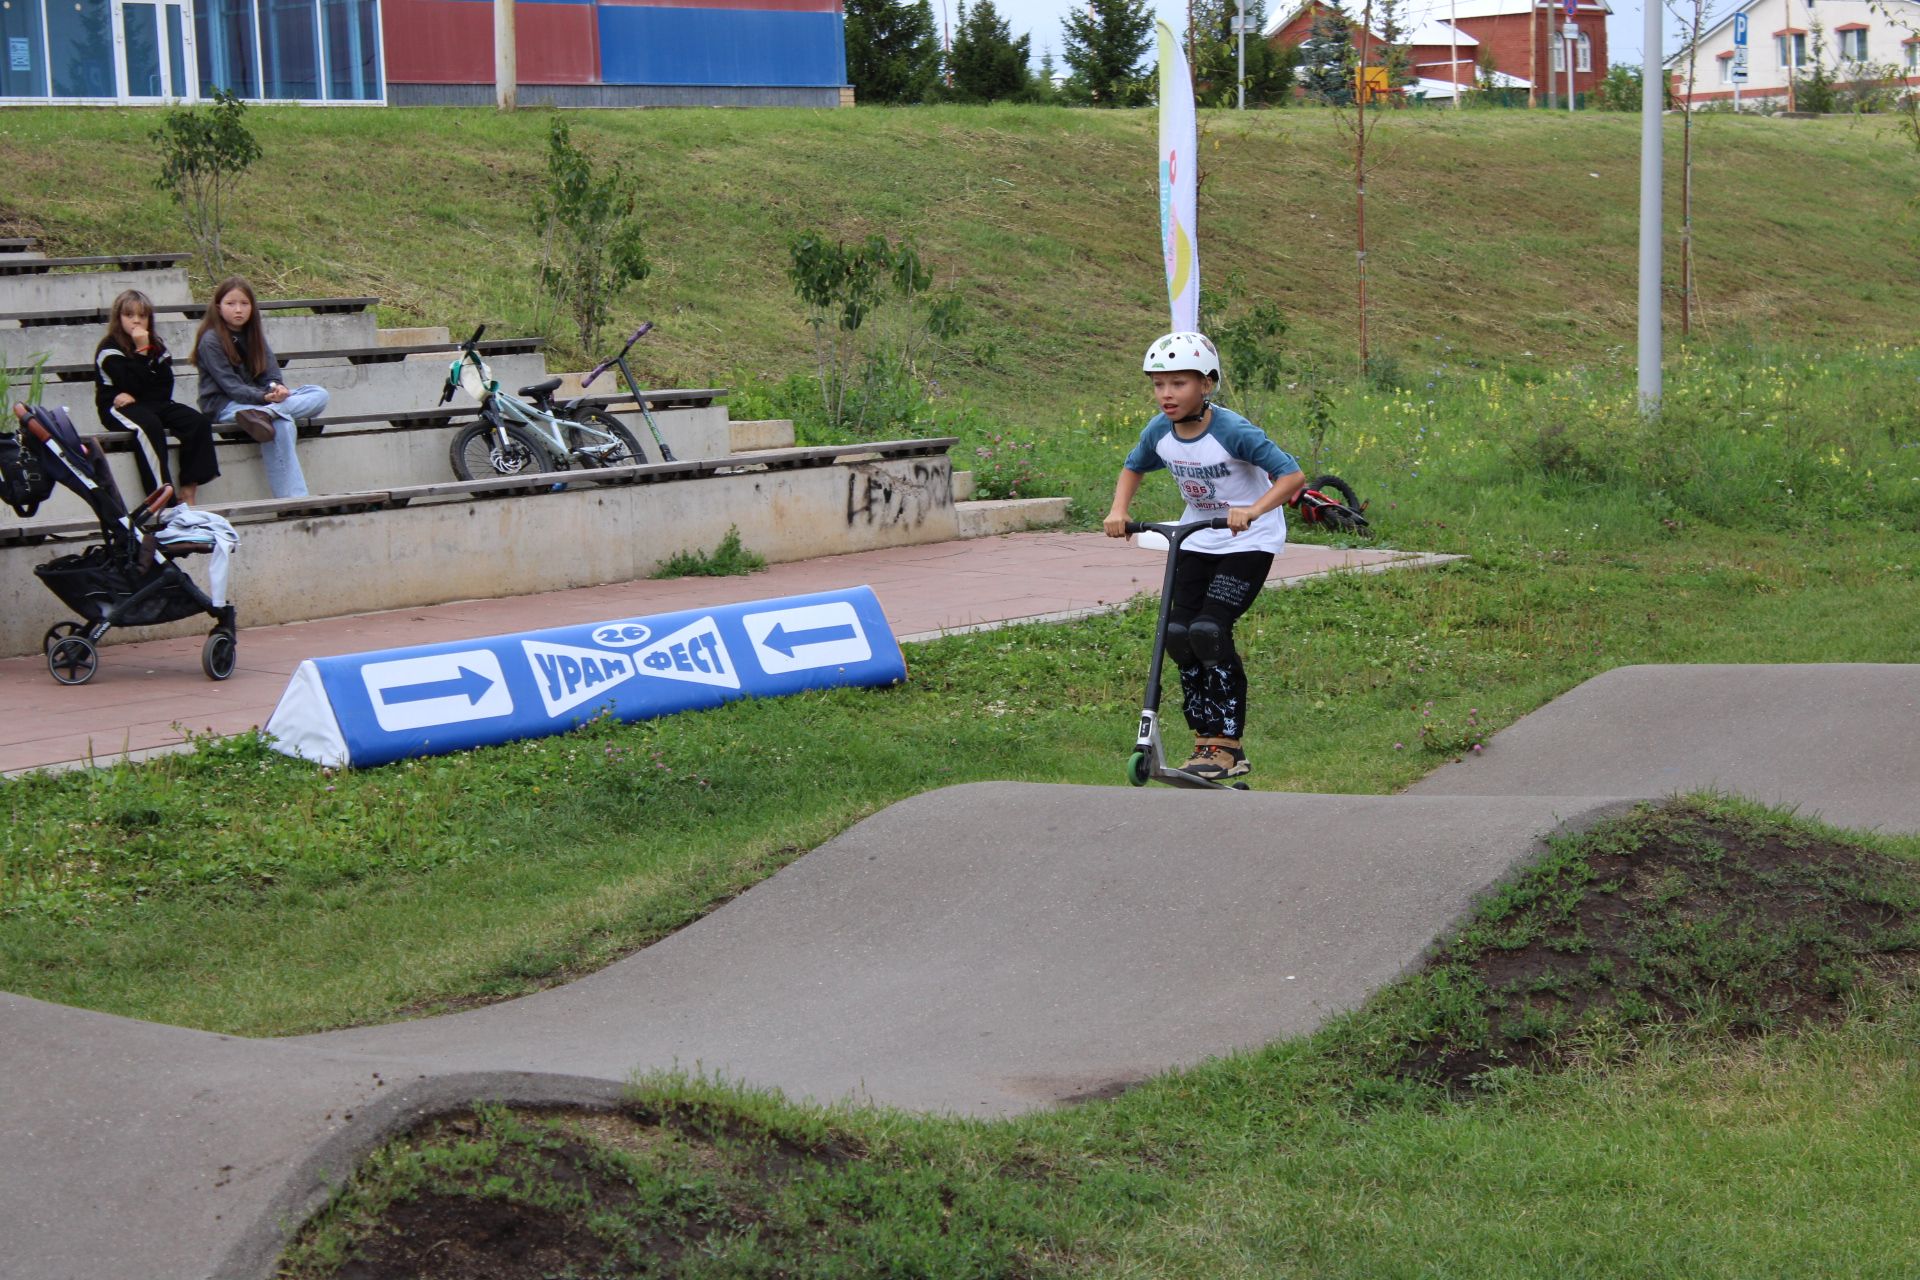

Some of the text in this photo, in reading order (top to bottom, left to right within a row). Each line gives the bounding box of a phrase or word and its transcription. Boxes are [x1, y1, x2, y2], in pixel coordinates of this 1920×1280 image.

[1737, 16, 1746, 42] P
[596, 626, 648, 643] 26
[534, 631, 725, 702] УРАМ ФЕСТ
